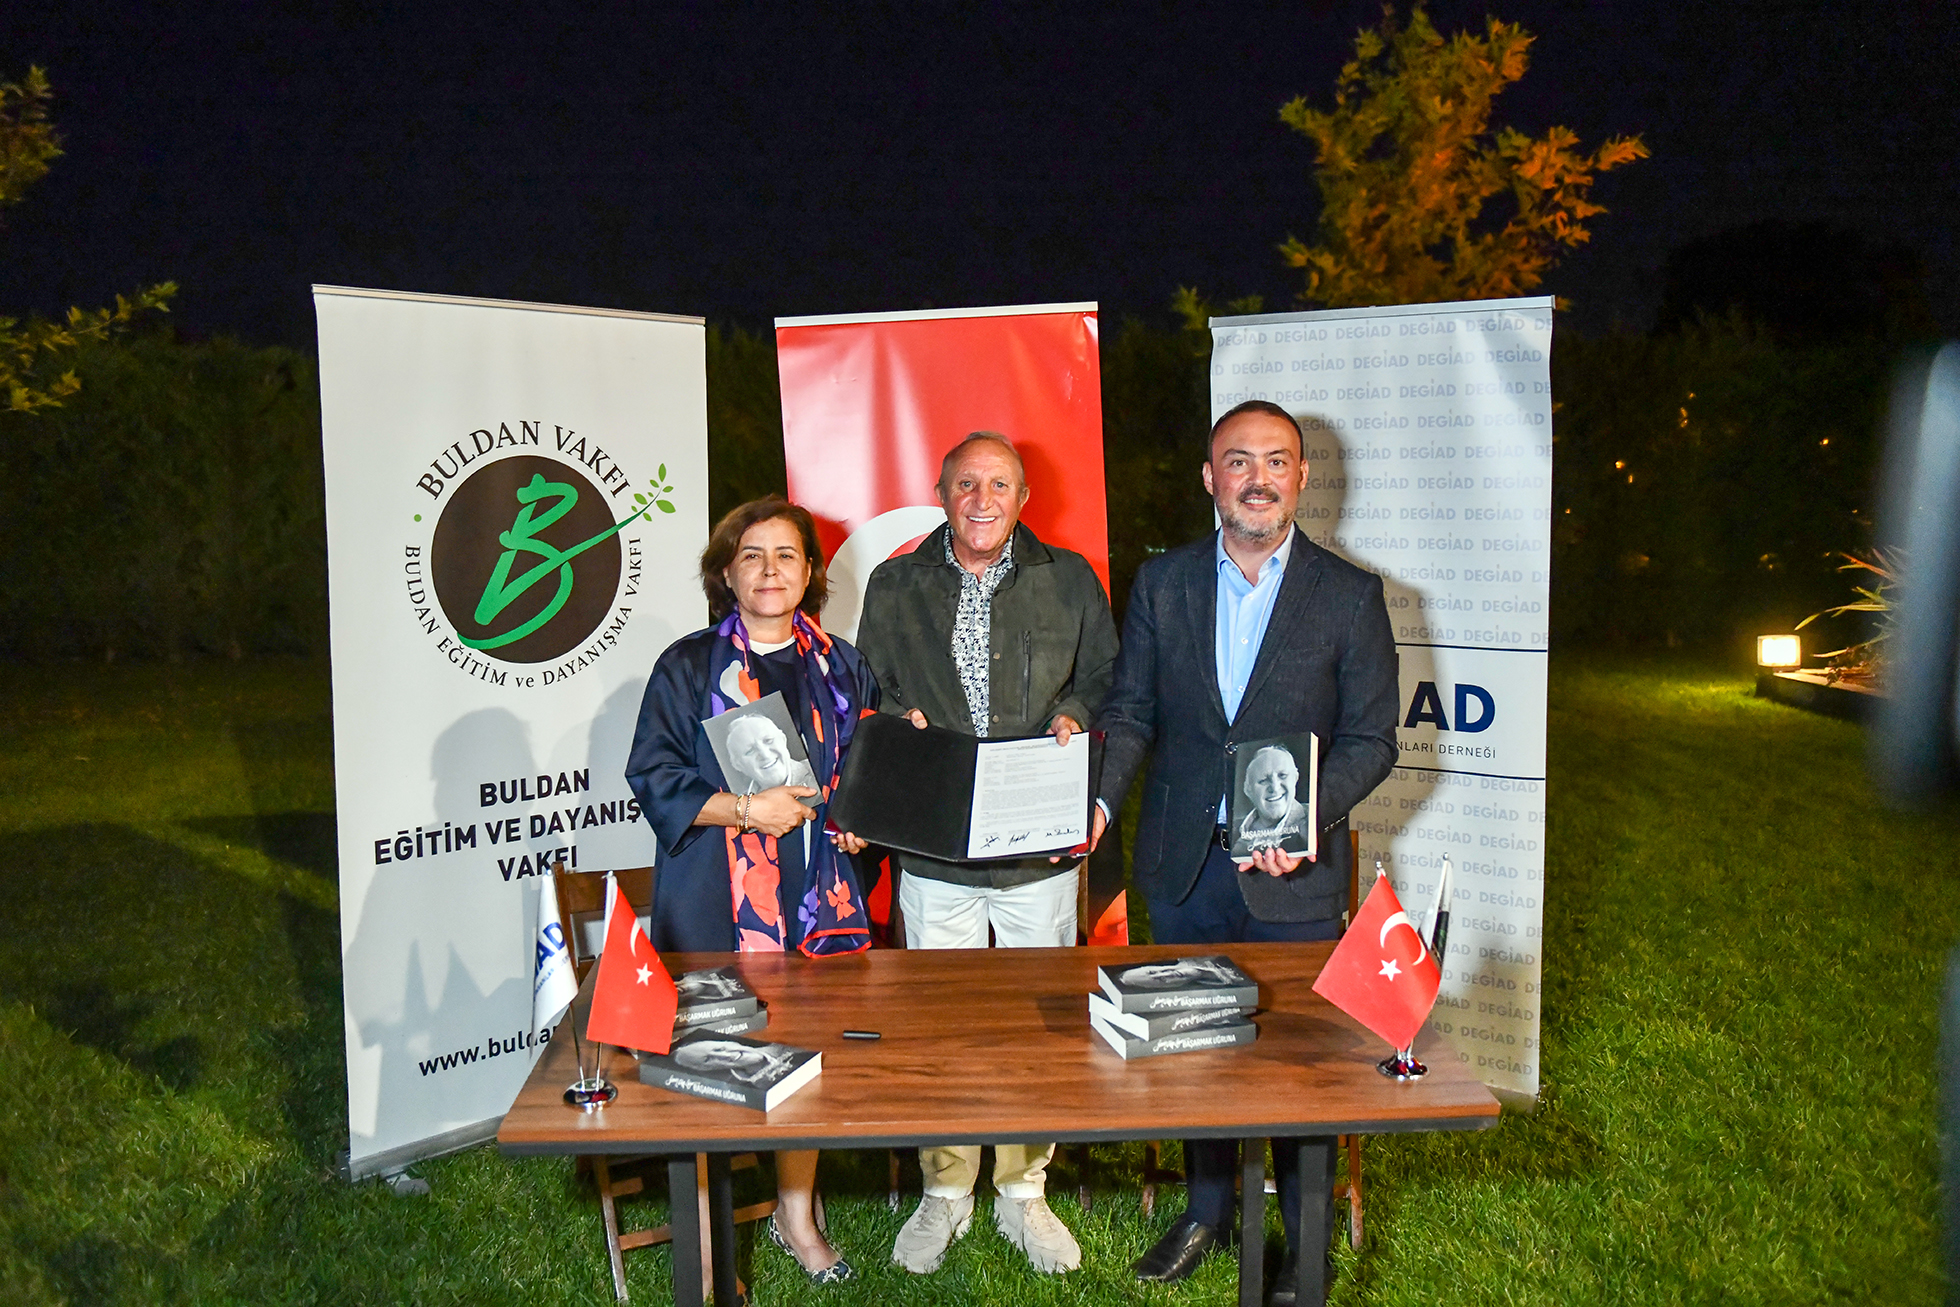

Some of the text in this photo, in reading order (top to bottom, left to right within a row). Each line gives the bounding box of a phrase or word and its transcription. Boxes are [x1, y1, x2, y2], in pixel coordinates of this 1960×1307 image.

[1299, 413, 1345, 431] EGİAD
[416, 420, 630, 500] BULDAN VAKFI
[405, 537, 642, 688] BULDAN EĞİTİM ve DAYANIŞMA VAKFI
[1396, 681, 1496, 733] AD
[1396, 741, 1433, 753] NLARI
[480, 768, 590, 807] BULDAN
[374, 797, 641, 865] EĞİTİM VE DAYANIŞ
[497, 845, 577, 882] VAKFI
[419, 1026, 558, 1076] www.bulda
